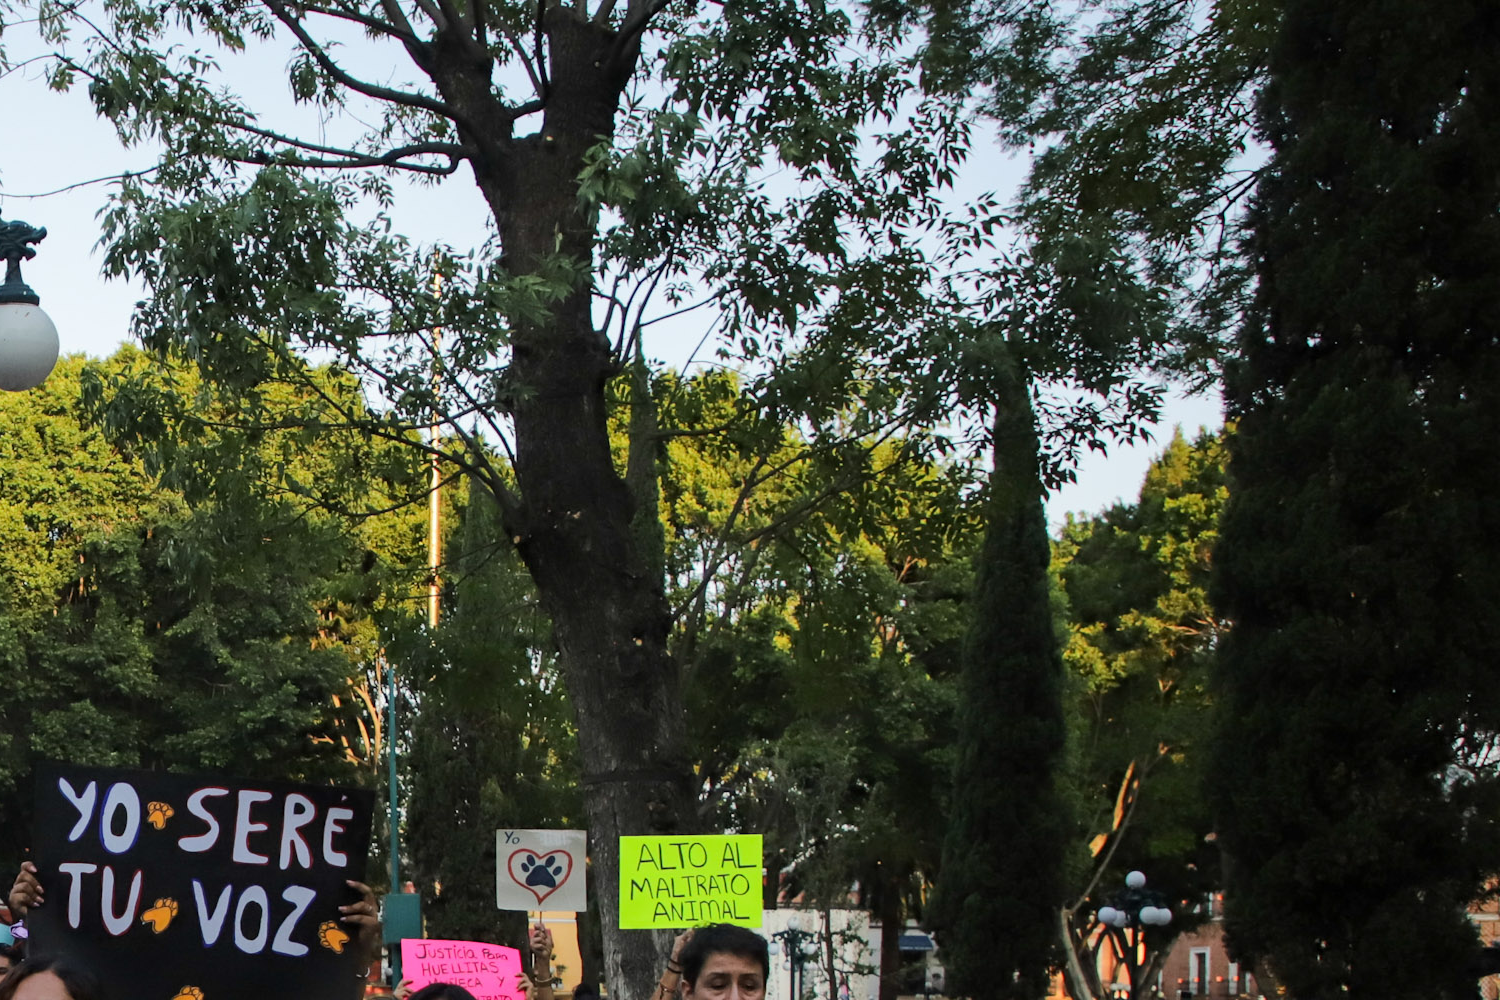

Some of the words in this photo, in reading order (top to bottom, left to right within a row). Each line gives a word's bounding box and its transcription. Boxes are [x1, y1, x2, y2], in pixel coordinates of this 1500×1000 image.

[59, 776, 141, 854] YO
[636, 842, 708, 871] ALTO
[721, 842, 757, 868] AL
[630, 873, 750, 900] MALTRATO
[59, 861, 142, 936] TU
[191, 878, 316, 957] VOZ
[653, 900, 750, 922] ANIMAL
[421, 961, 499, 976] HUELLITAS
